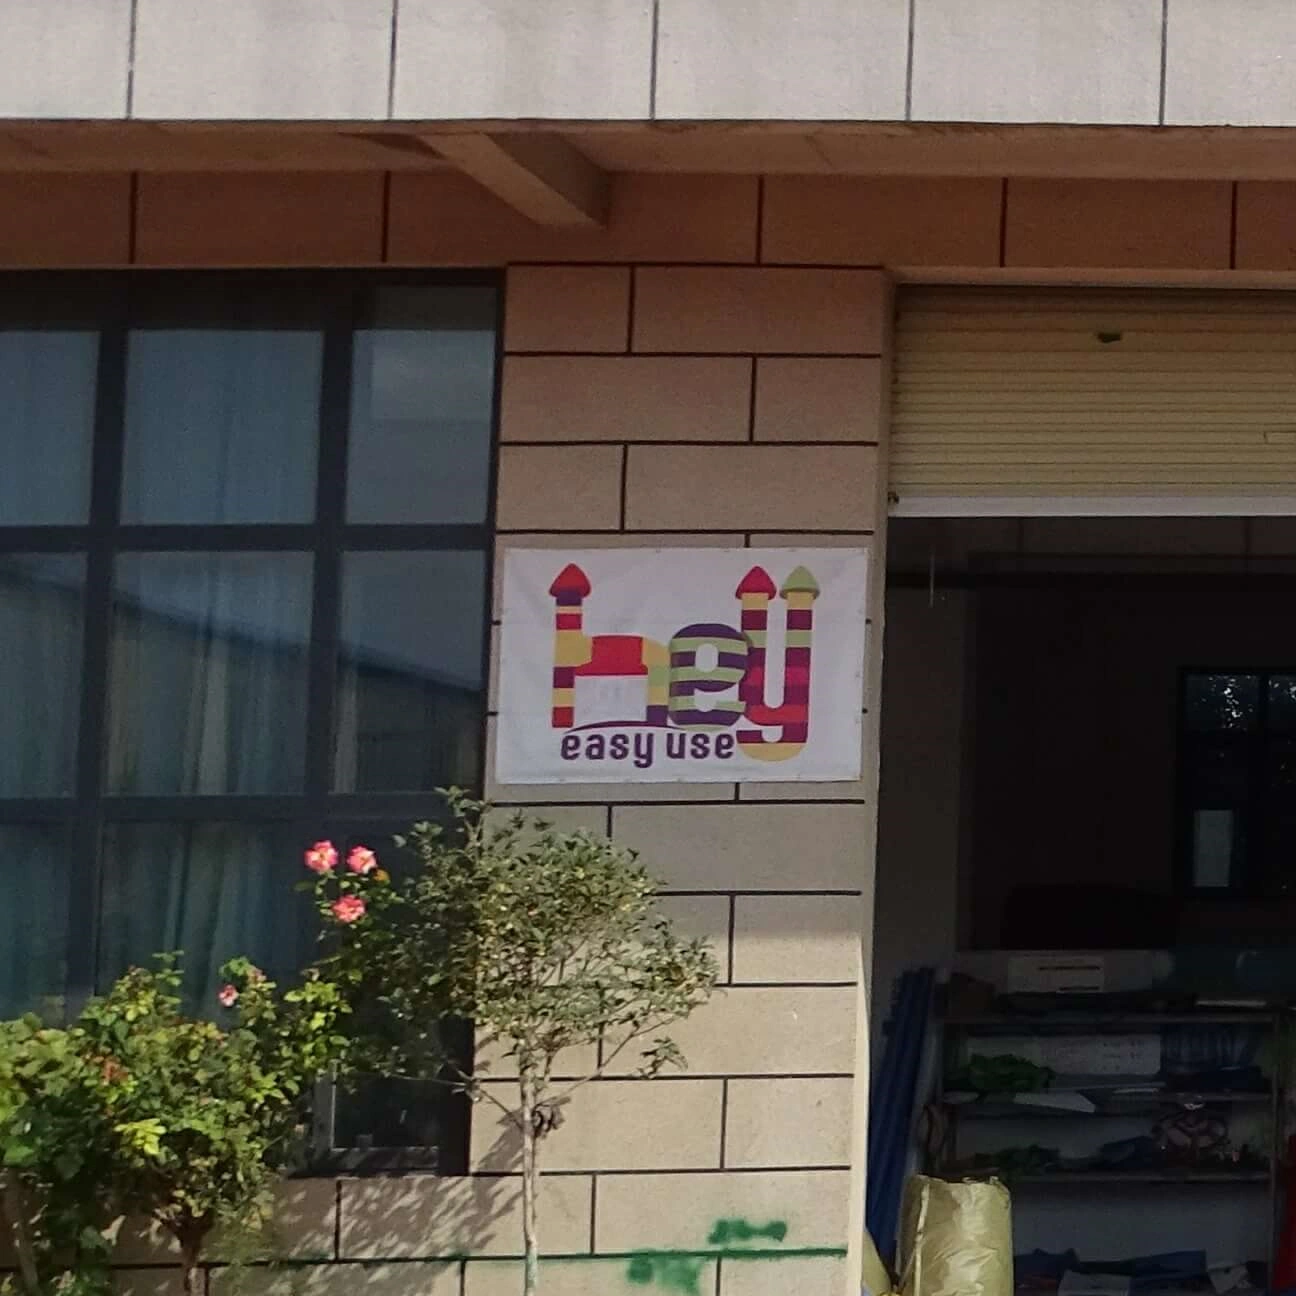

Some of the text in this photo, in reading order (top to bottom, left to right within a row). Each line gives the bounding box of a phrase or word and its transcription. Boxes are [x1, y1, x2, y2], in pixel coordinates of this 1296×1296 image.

[549, 563, 820, 761] hey
[561, 732, 734, 768] easy use
